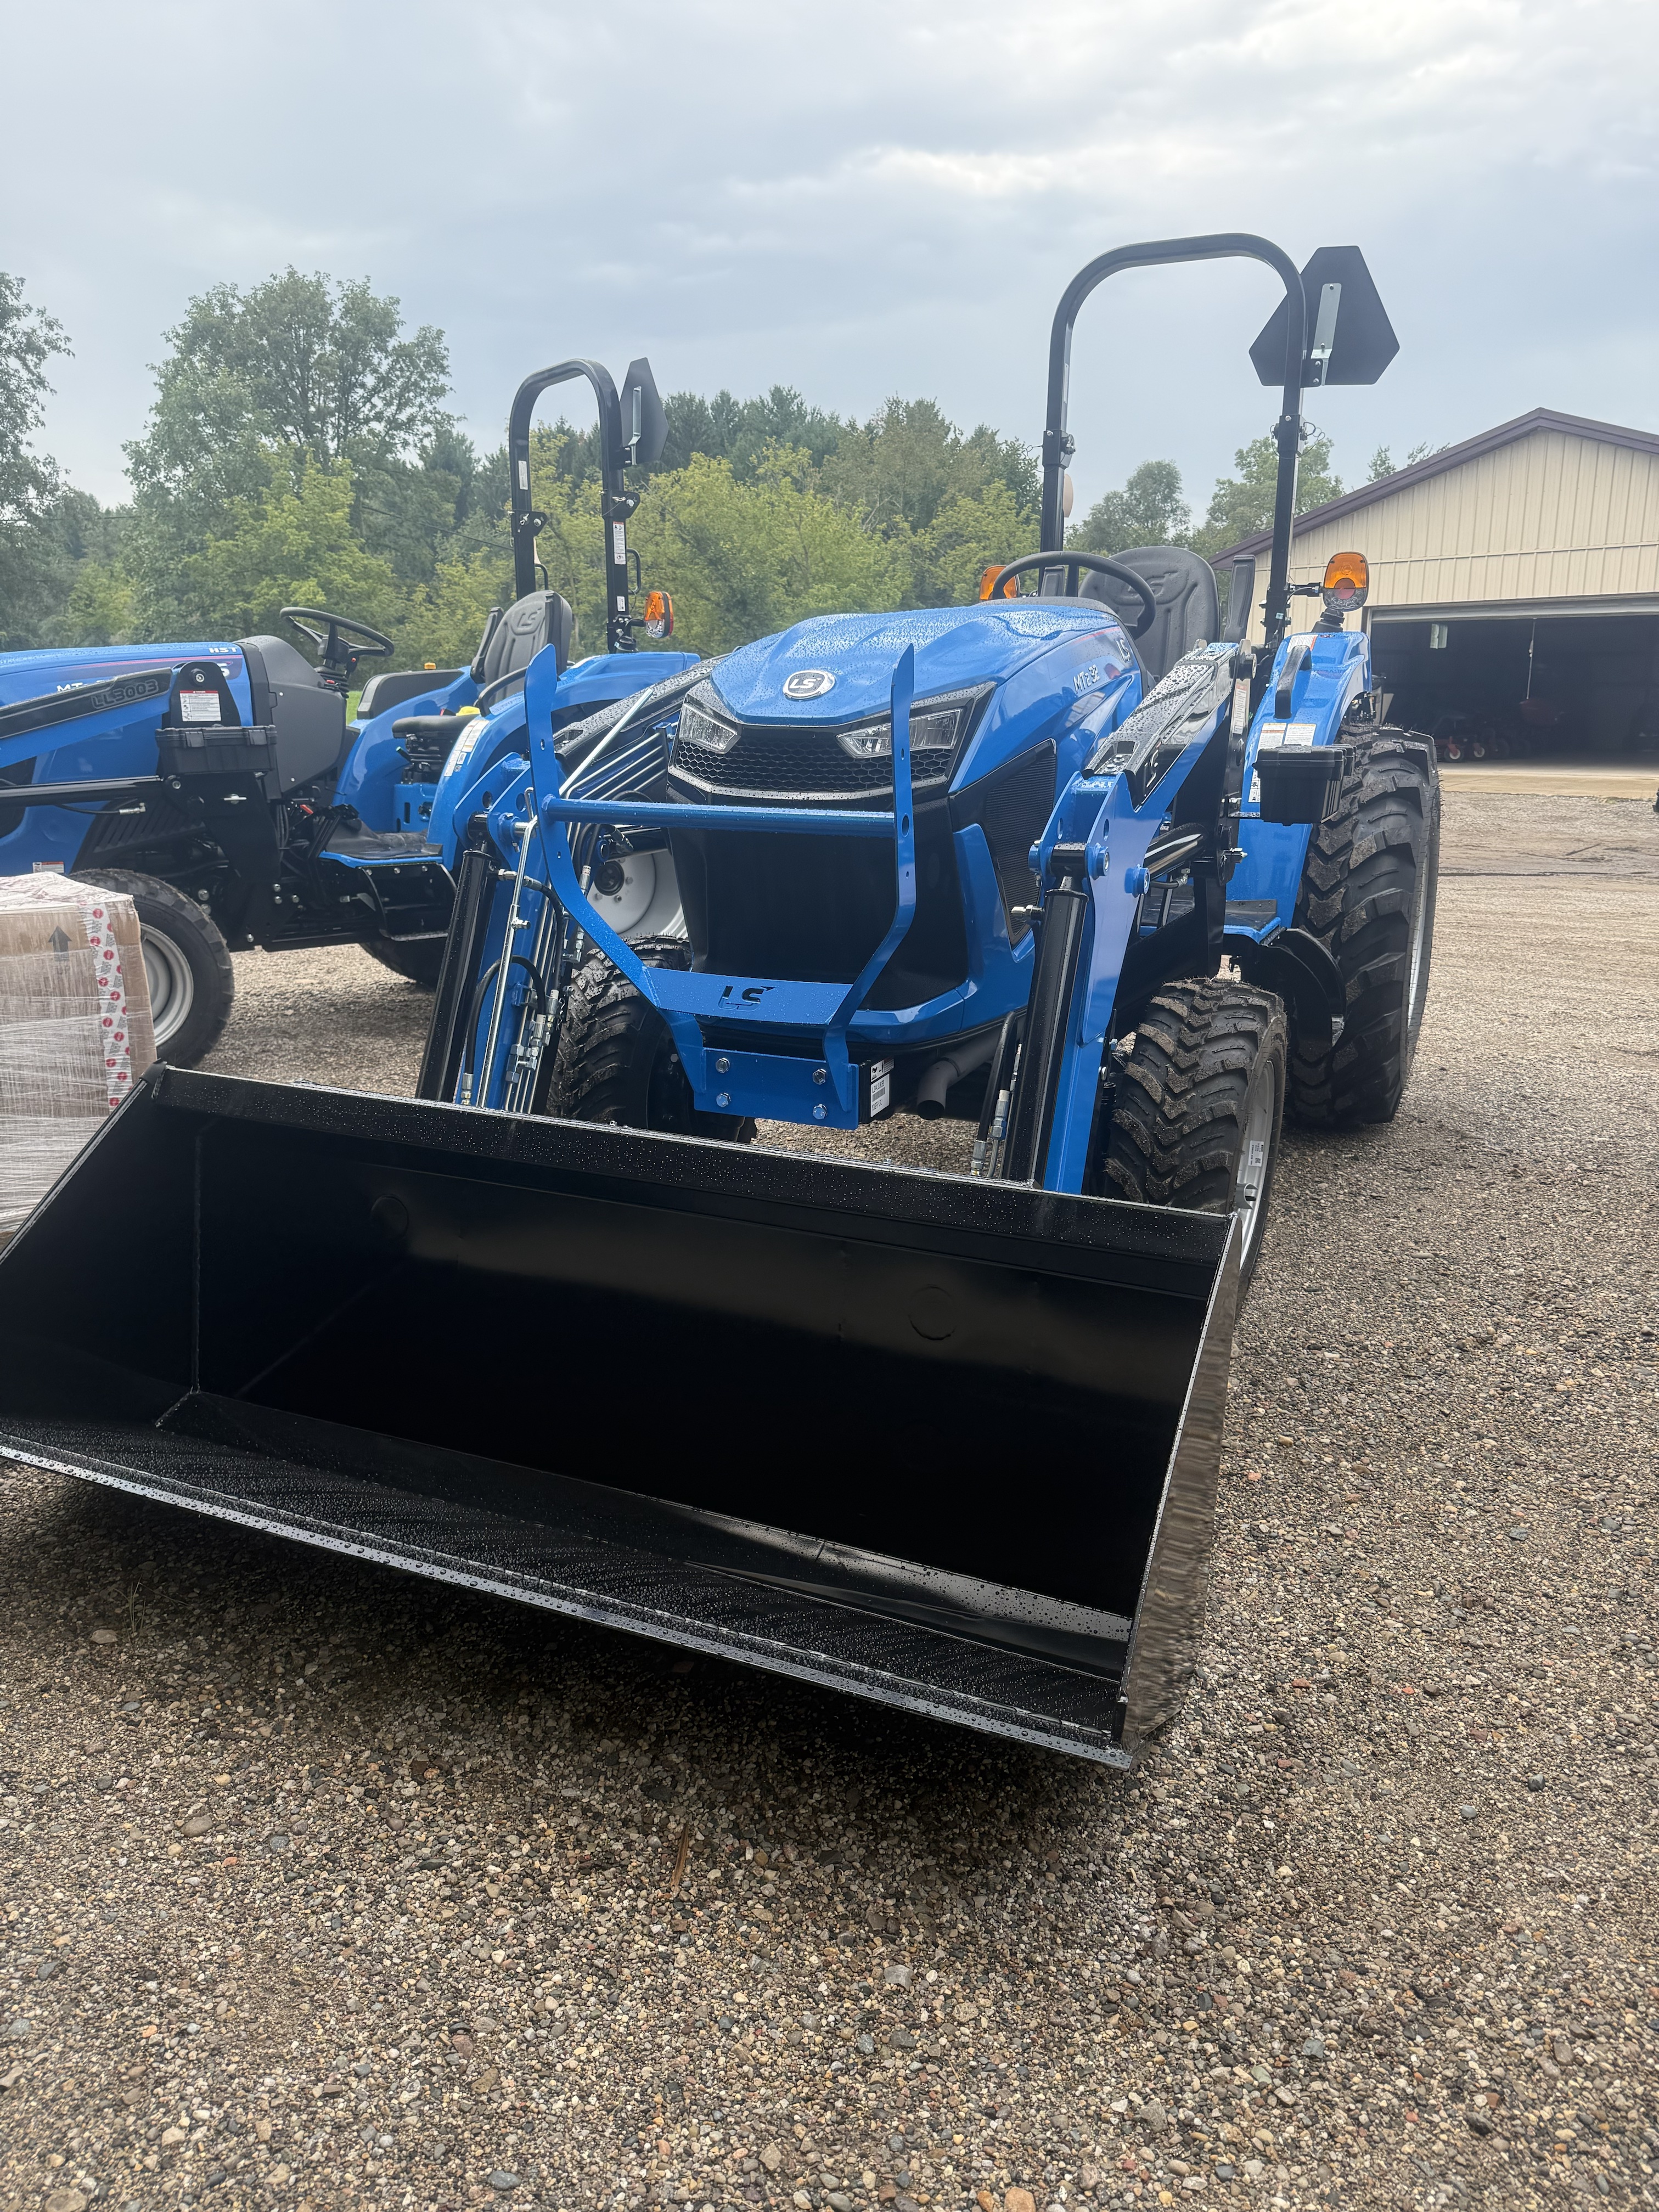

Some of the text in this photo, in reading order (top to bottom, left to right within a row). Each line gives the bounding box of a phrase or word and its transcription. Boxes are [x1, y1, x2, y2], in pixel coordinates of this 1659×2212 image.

[91, 679, 158, 709] LL3003
[789, 678, 819, 689] LS
[718, 986, 766, 1012] LS
